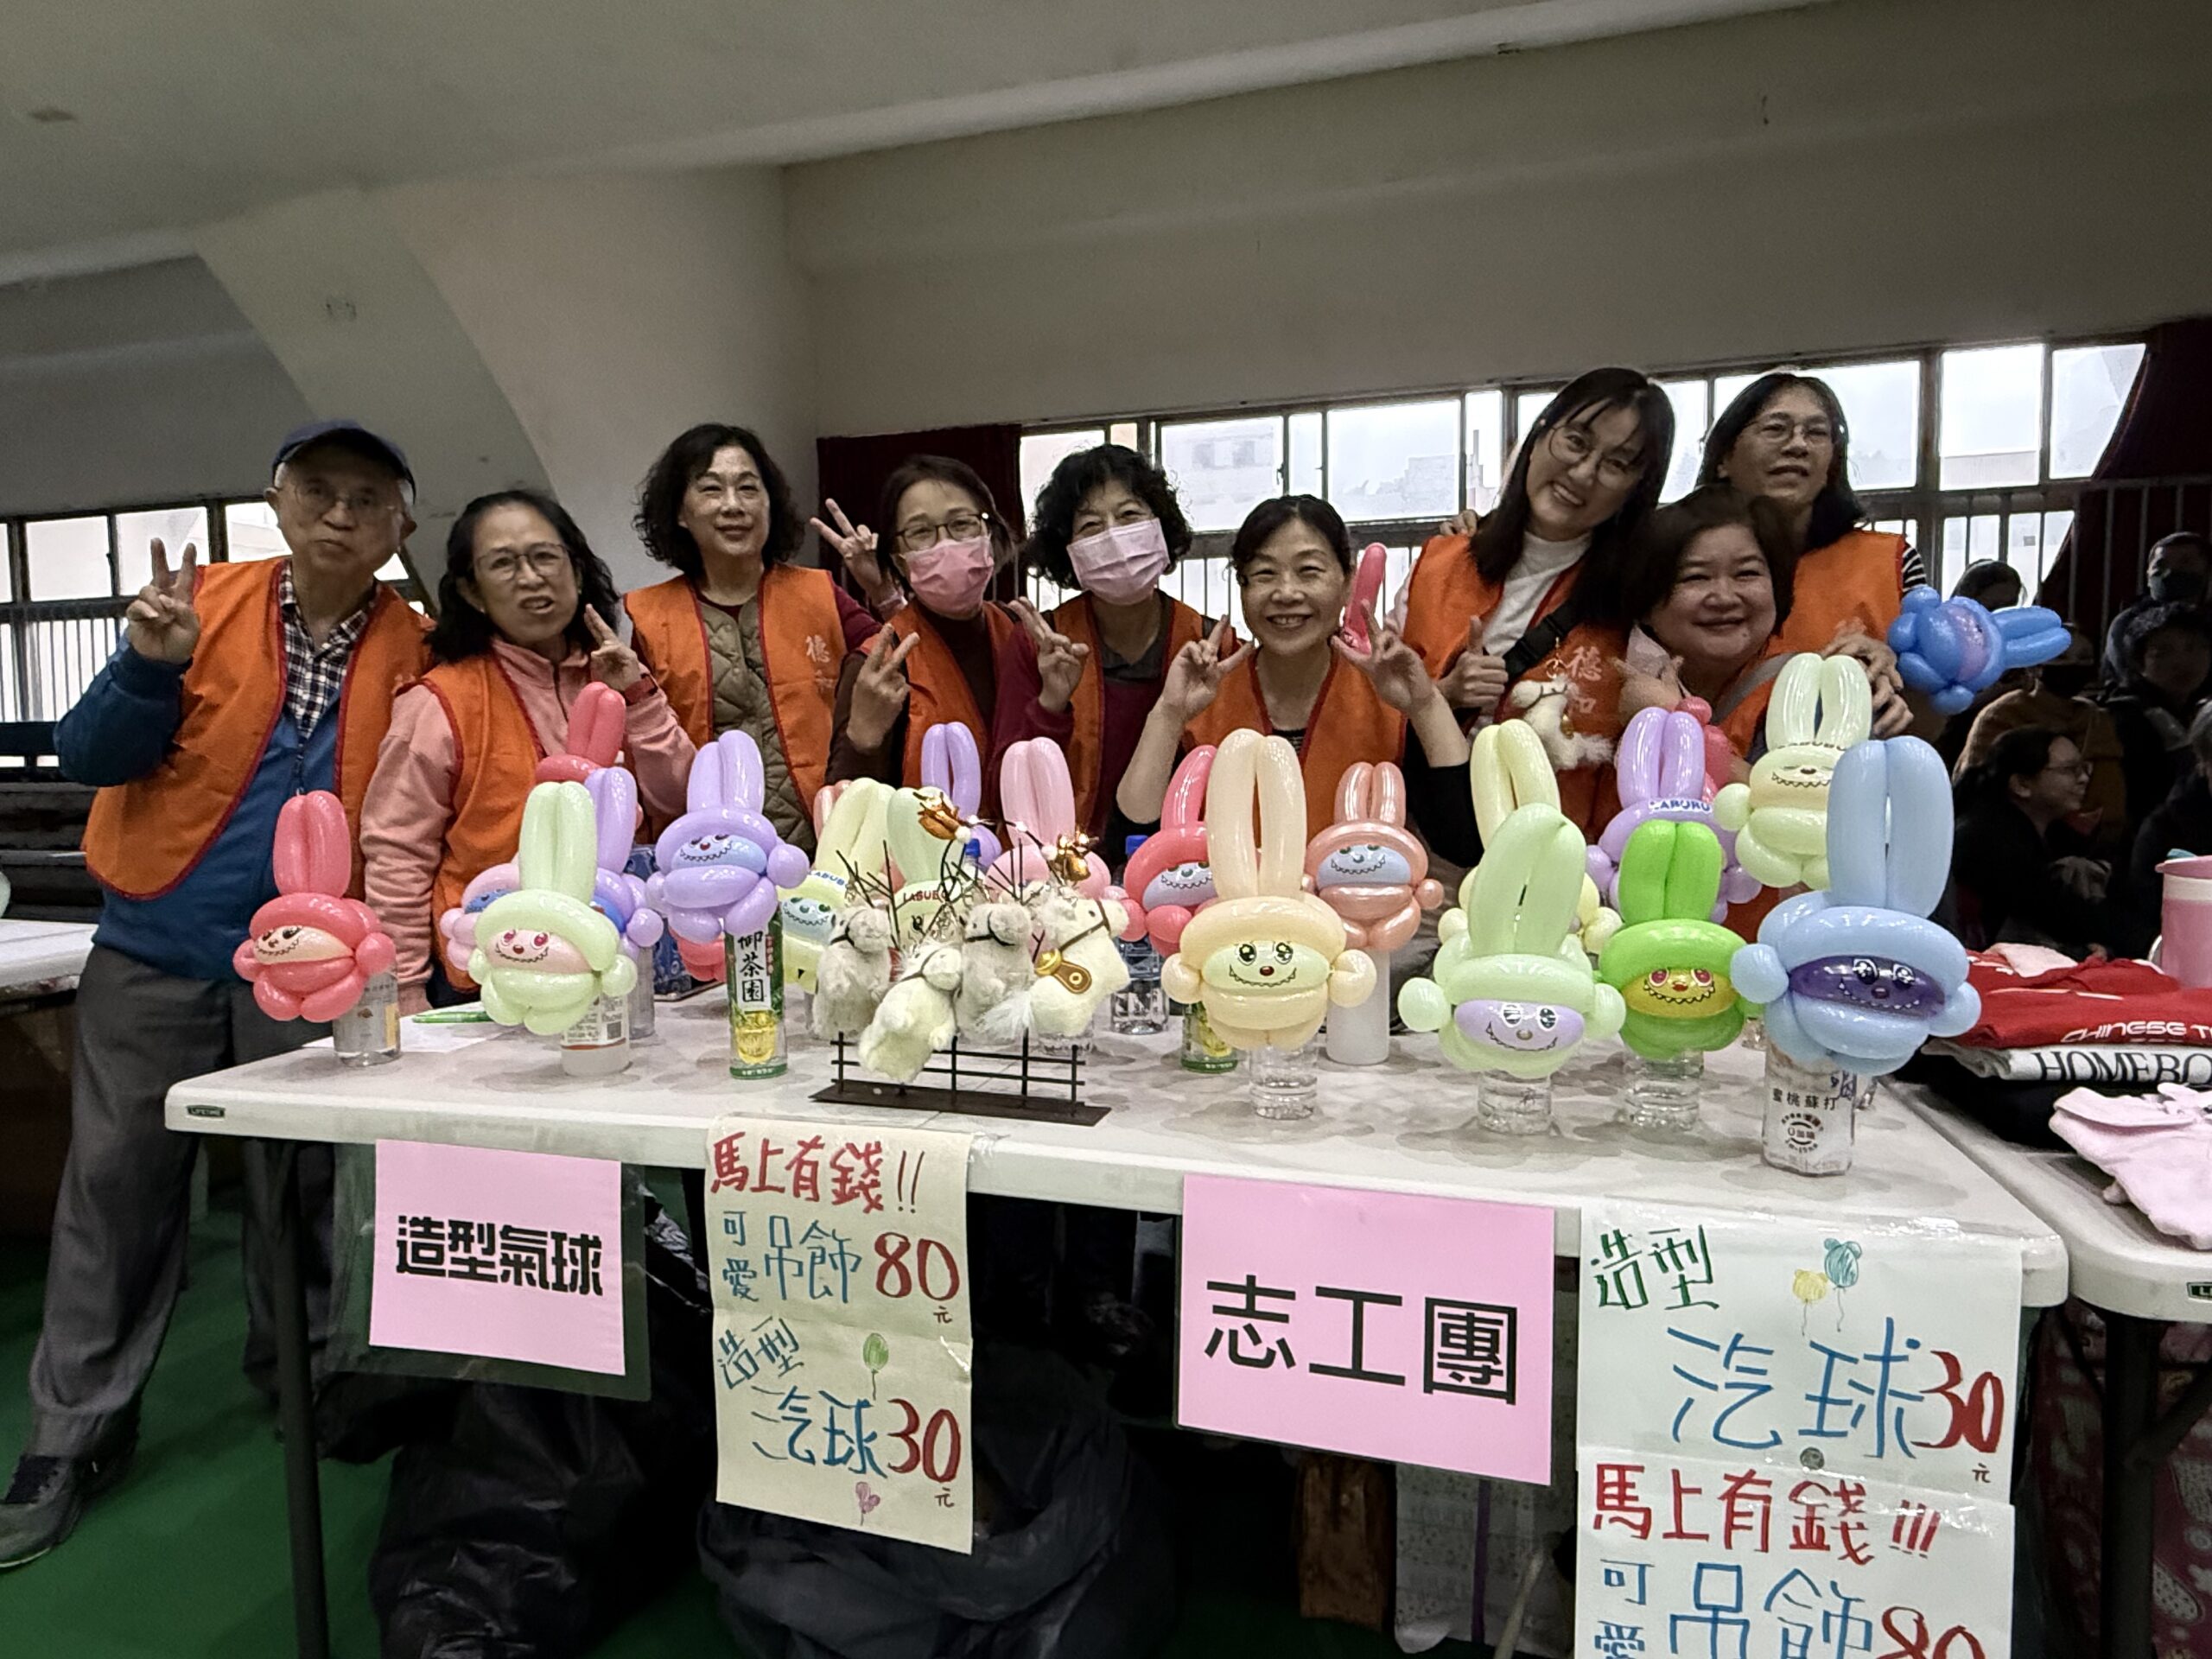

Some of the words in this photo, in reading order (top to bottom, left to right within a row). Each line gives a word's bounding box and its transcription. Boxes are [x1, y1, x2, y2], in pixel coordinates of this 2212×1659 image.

[2060, 1020, 2187, 1043] CHINESE
[2190, 1023, 2212, 1039] T
[396, 1215, 603, 1297] 造型氣球
[765, 1215, 862, 1305] 吊飾
[874, 1231, 961, 1302] 80
[1590, 1224, 1720, 1311] 造型
[716, 1316, 804, 1389] 造型
[1204, 1274, 1518, 1406] 志工團
[887, 1398, 961, 1484] 30
[1911, 1351, 2005, 1453] 30
